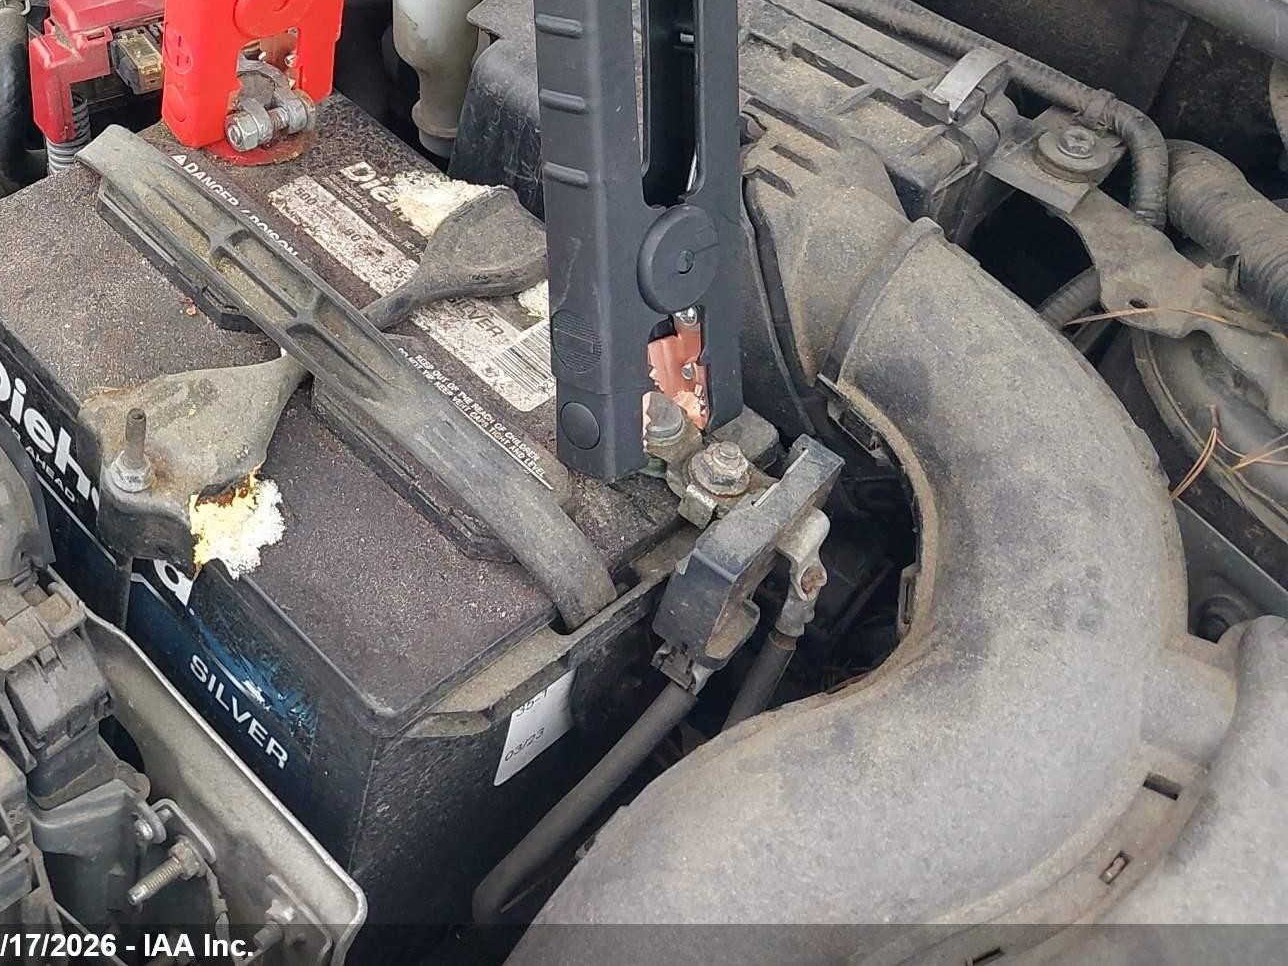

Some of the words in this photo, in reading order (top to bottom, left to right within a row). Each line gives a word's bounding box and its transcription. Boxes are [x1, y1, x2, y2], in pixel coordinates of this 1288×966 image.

[183, 159, 240, 207] DANGER
[294, 187, 318, 206] 500
[414, 354, 435, 371] KEEP
[432, 369, 448, 384] OUT
[446, 381, 459, 392] OF
[457, 390, 474, 405] THE
[471, 402, 496, 425] REACH
[493, 422, 508, 435] OF
[504, 430, 541, 461] CHILDREN
[451, 396, 473, 413] VENT
[469, 411, 489, 429] CAPS
[488, 426, 512, 447] TIGHT
[508, 443, 526, 460] AND
[524, 456, 547, 479] LEVEL
[190, 653, 290, 770] SILVER
[504, 726, 546, 763] 03/23
